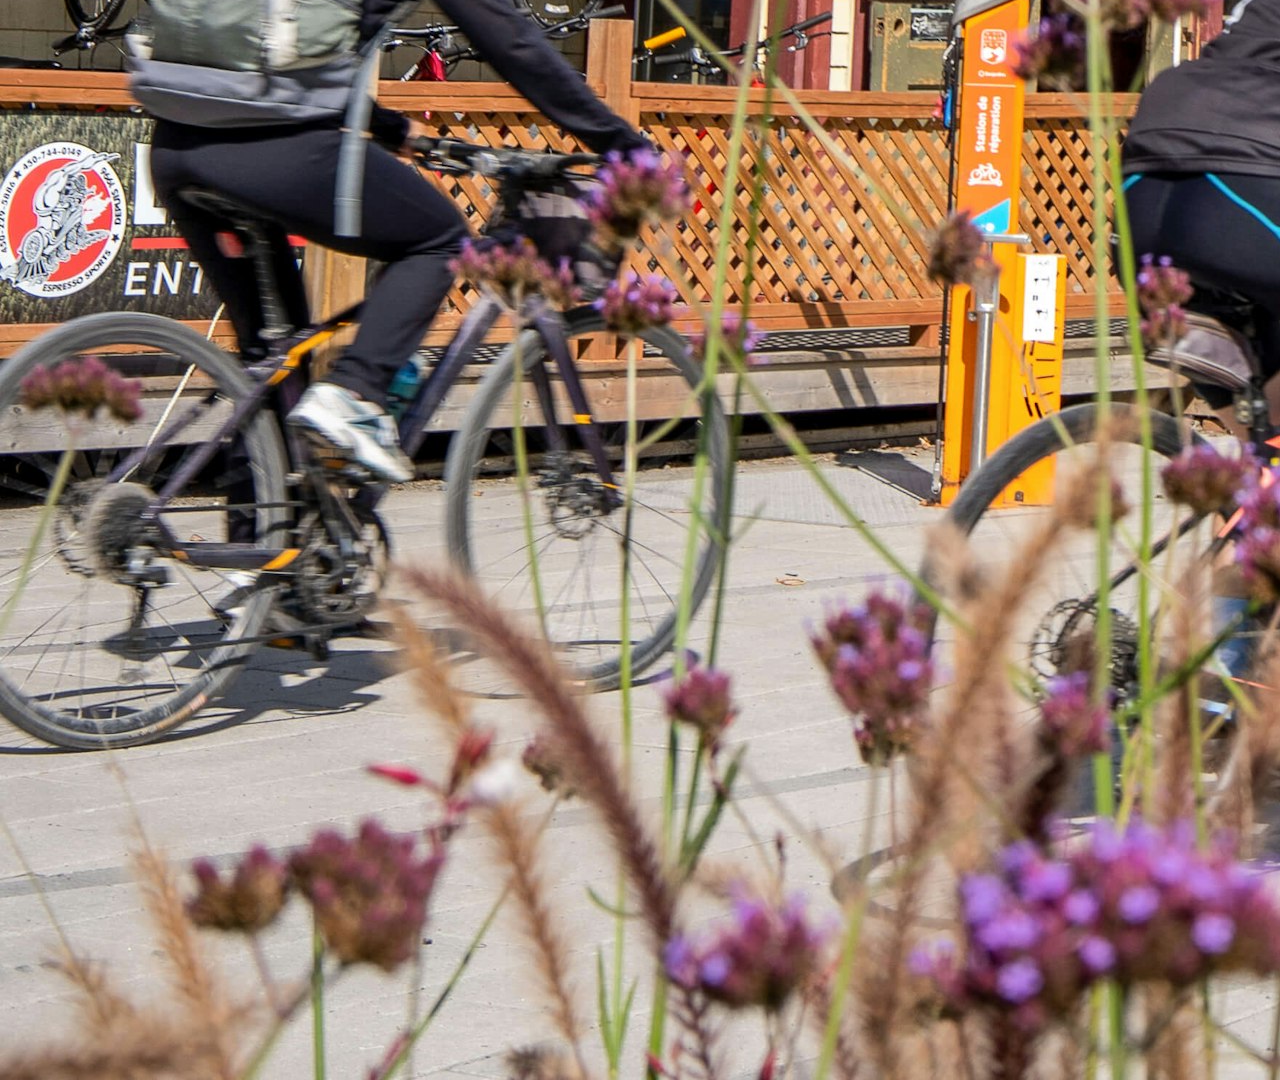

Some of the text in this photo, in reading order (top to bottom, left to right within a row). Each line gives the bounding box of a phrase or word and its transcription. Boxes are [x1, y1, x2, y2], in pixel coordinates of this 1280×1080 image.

[975, 95, 989, 152] Station de
[988, 96, 1002, 153] réparation
[23, 147, 82, 170] 450-744-0149
[110, 190, 123, 225] DEPUIS
[42, 250, 112, 292] ESPRESSO SPORTS
